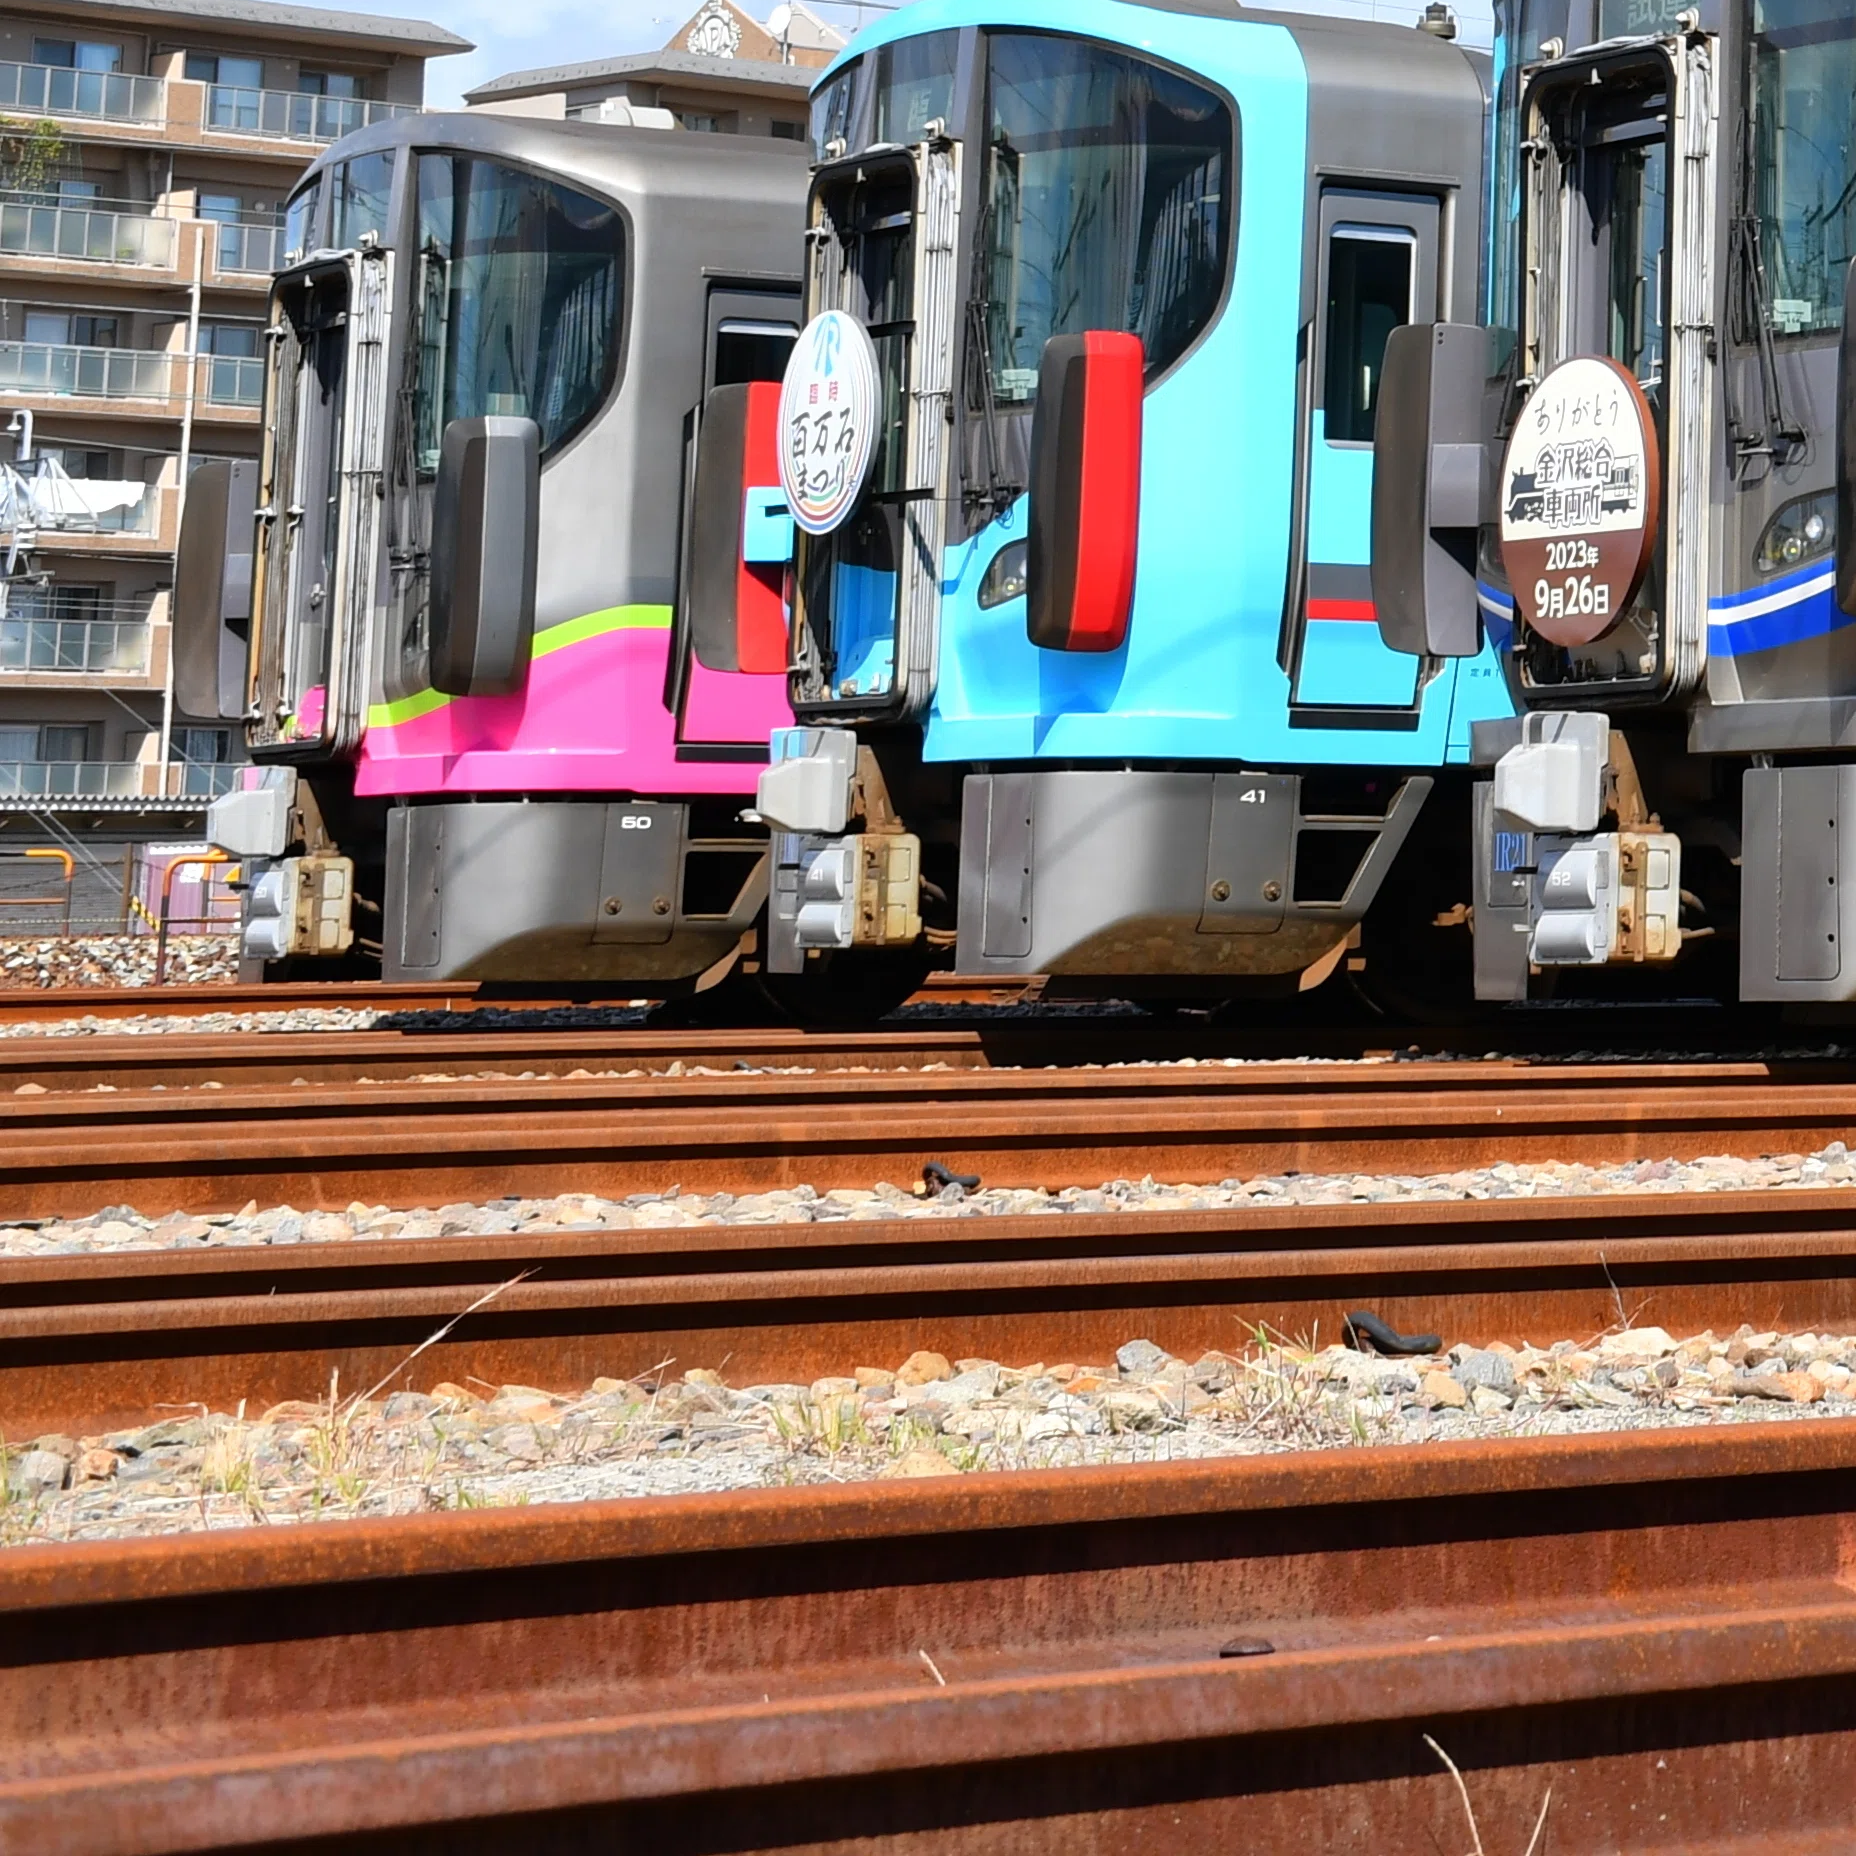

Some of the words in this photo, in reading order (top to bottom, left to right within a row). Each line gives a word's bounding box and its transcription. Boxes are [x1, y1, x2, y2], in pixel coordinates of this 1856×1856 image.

[1535, 389, 1618, 436] ありがとう
[791, 407, 855, 458] 百万石
[1536, 442, 1612, 485] 金沢総合
[1545, 485, 1601, 524] 車両所
[1545, 540, 1599, 569] 2023年
[1535, 575, 1609, 619] 9月26日
[1240, 789, 1266, 803] 41
[1495, 832, 1526, 871] IR21
[811, 868, 824, 881] 41
[1551, 871, 1571, 886] 52
